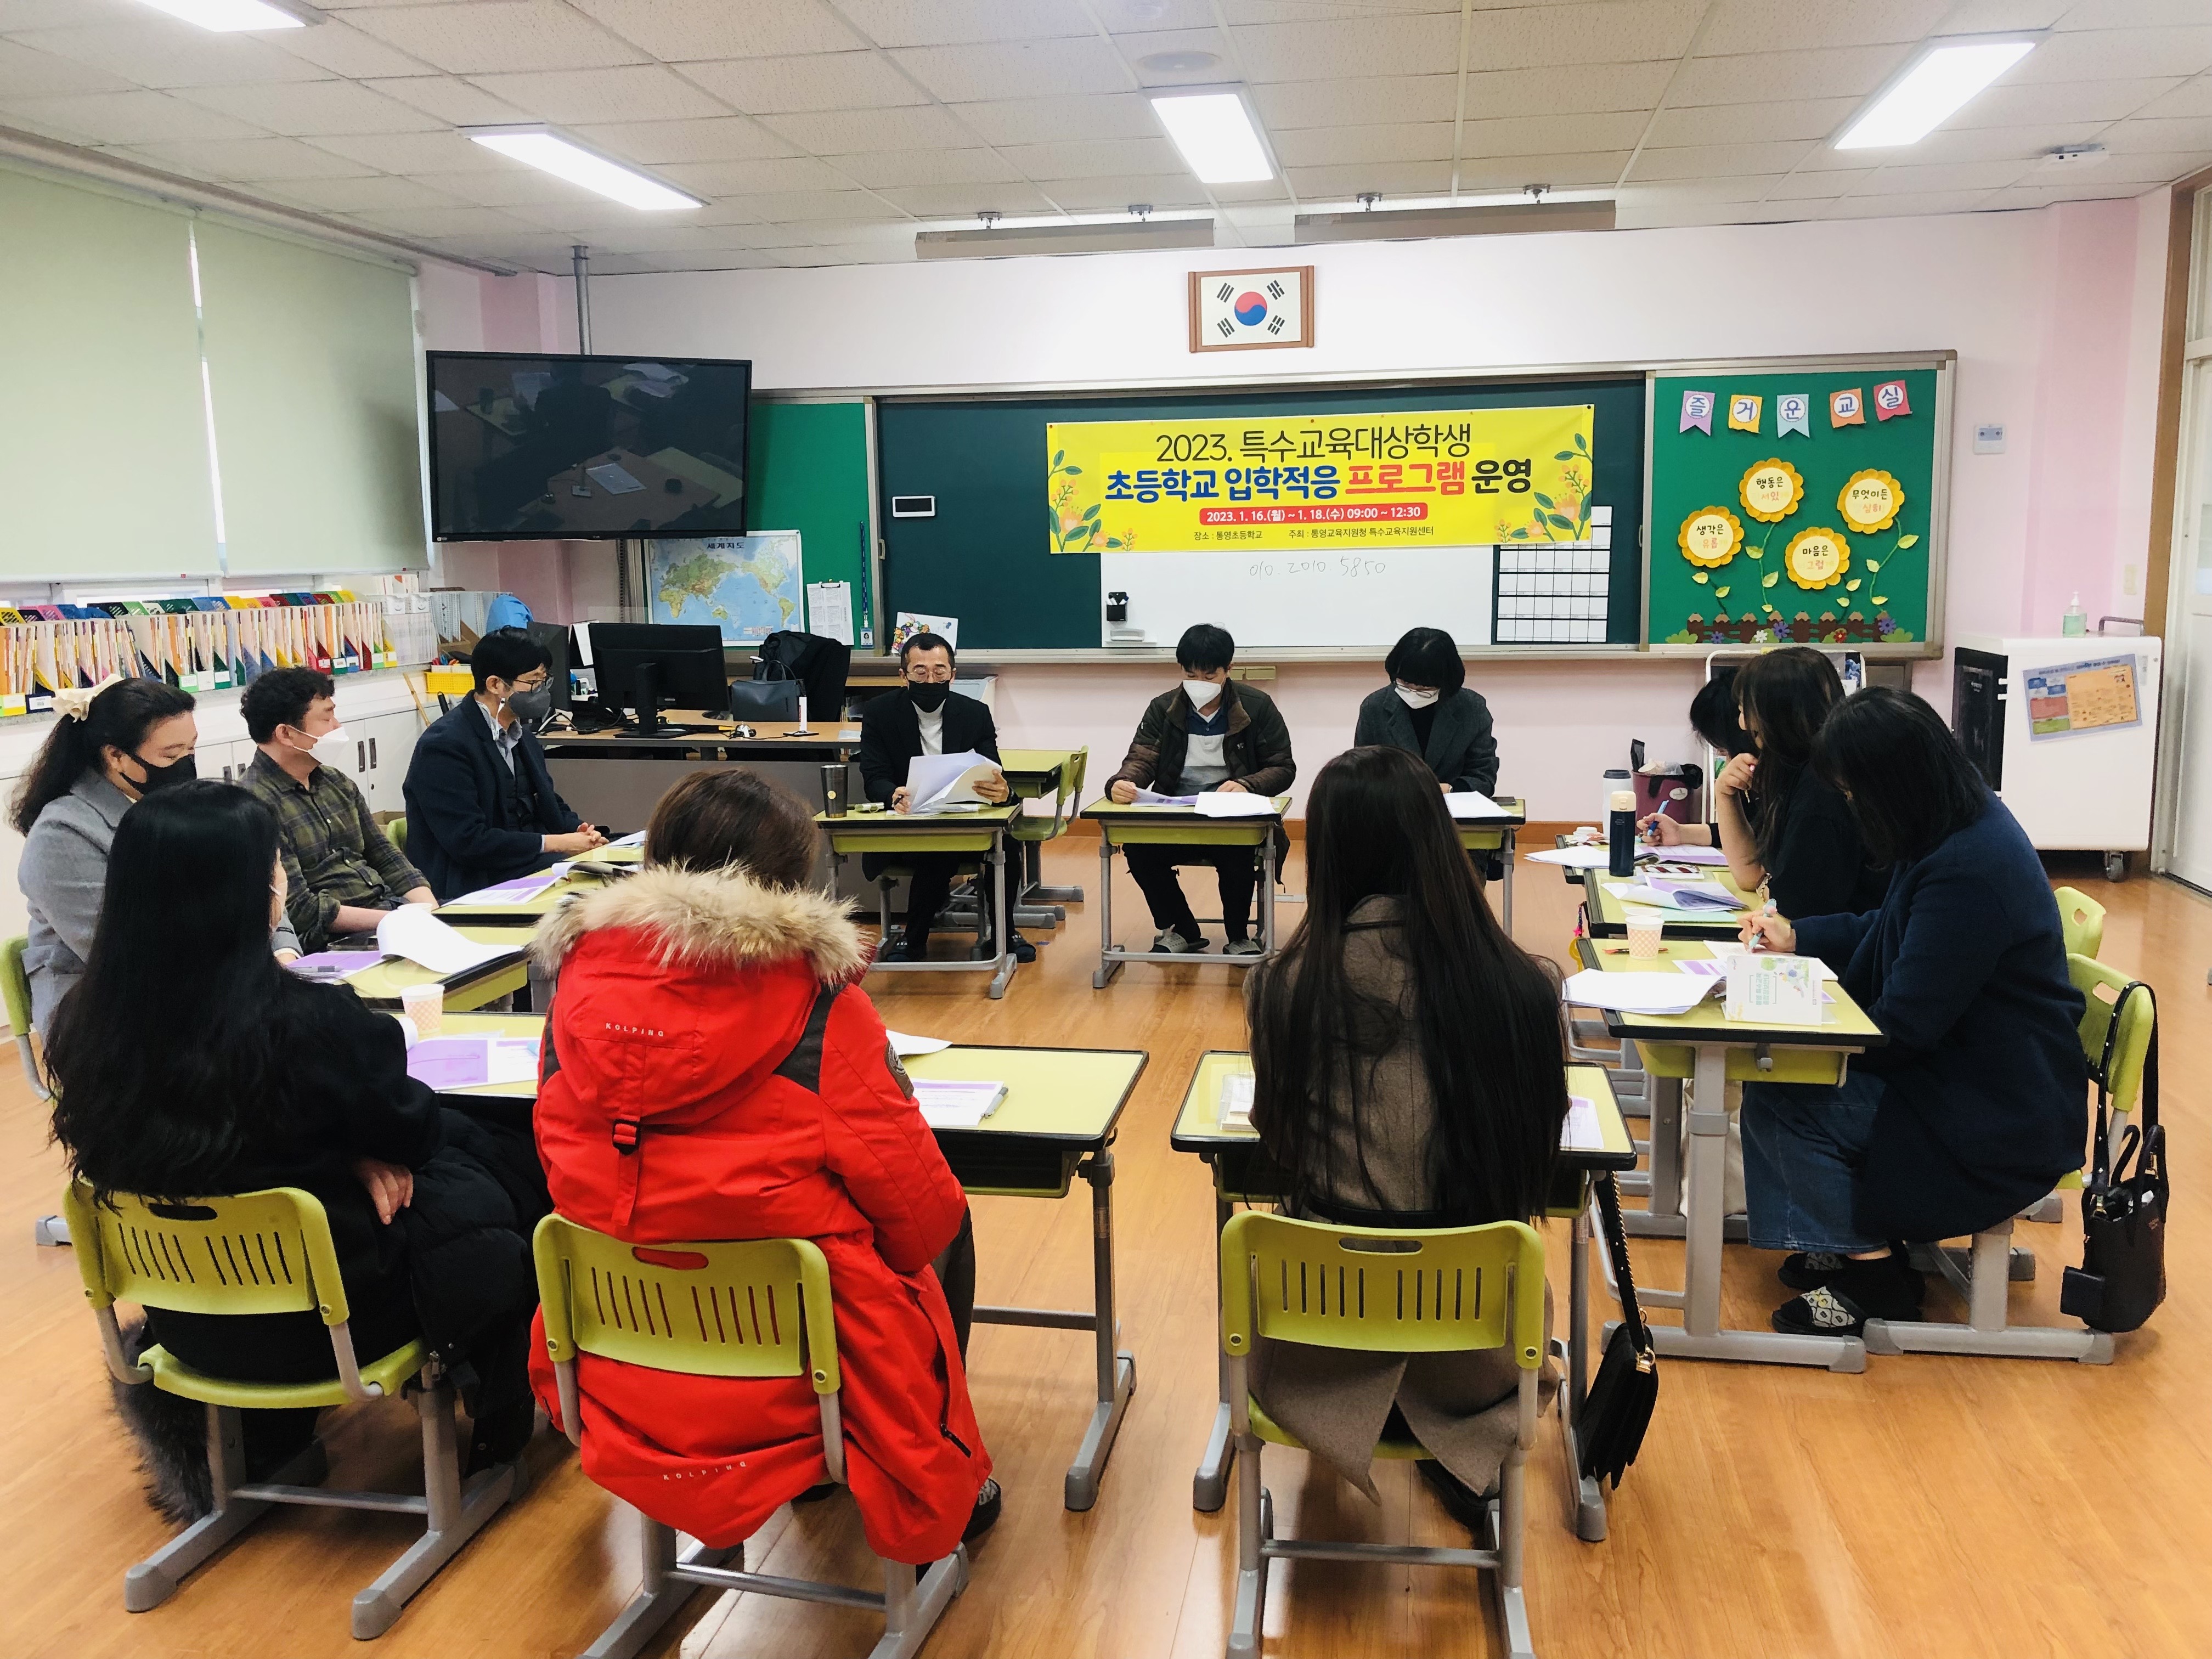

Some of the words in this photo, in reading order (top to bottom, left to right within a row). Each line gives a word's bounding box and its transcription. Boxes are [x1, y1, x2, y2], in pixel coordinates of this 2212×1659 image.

[1156, 434, 1232, 462] 2023.
[1239, 423, 1471, 464] 특수교육대상학생
[1105, 468, 1220, 503] 초등학교
[1224, 465, 1341, 501] 입학적응
[1345, 461, 1465, 495] 프로그램
[1471, 458, 1531, 494] 운영
[1756, 476, 1784, 489] 행동은
[1852, 488, 1887, 500] 무엇이든
[1206, 511, 1237, 522] 2023.
[1251, 509, 1285, 522] 16.(월)
[1310, 507, 1344, 521] 18.(수)
[1347, 507, 1378, 519] 09:00
[1390, 506, 1421, 518] 12:30
[1216, 530, 1263, 540] 통영초등학교
[1311, 528, 1367, 539] 통영교육지원청
[1369, 526, 1434, 537] 특수교육지원센터
[1696, 523, 1724, 535] 생각은
[1803, 545, 1829, 557] 마음은
[1340, 556, 1385, 577] 5850
[606, 1022, 664, 1037] KOLPING
[663, 1461, 746, 1481] KOLPING
